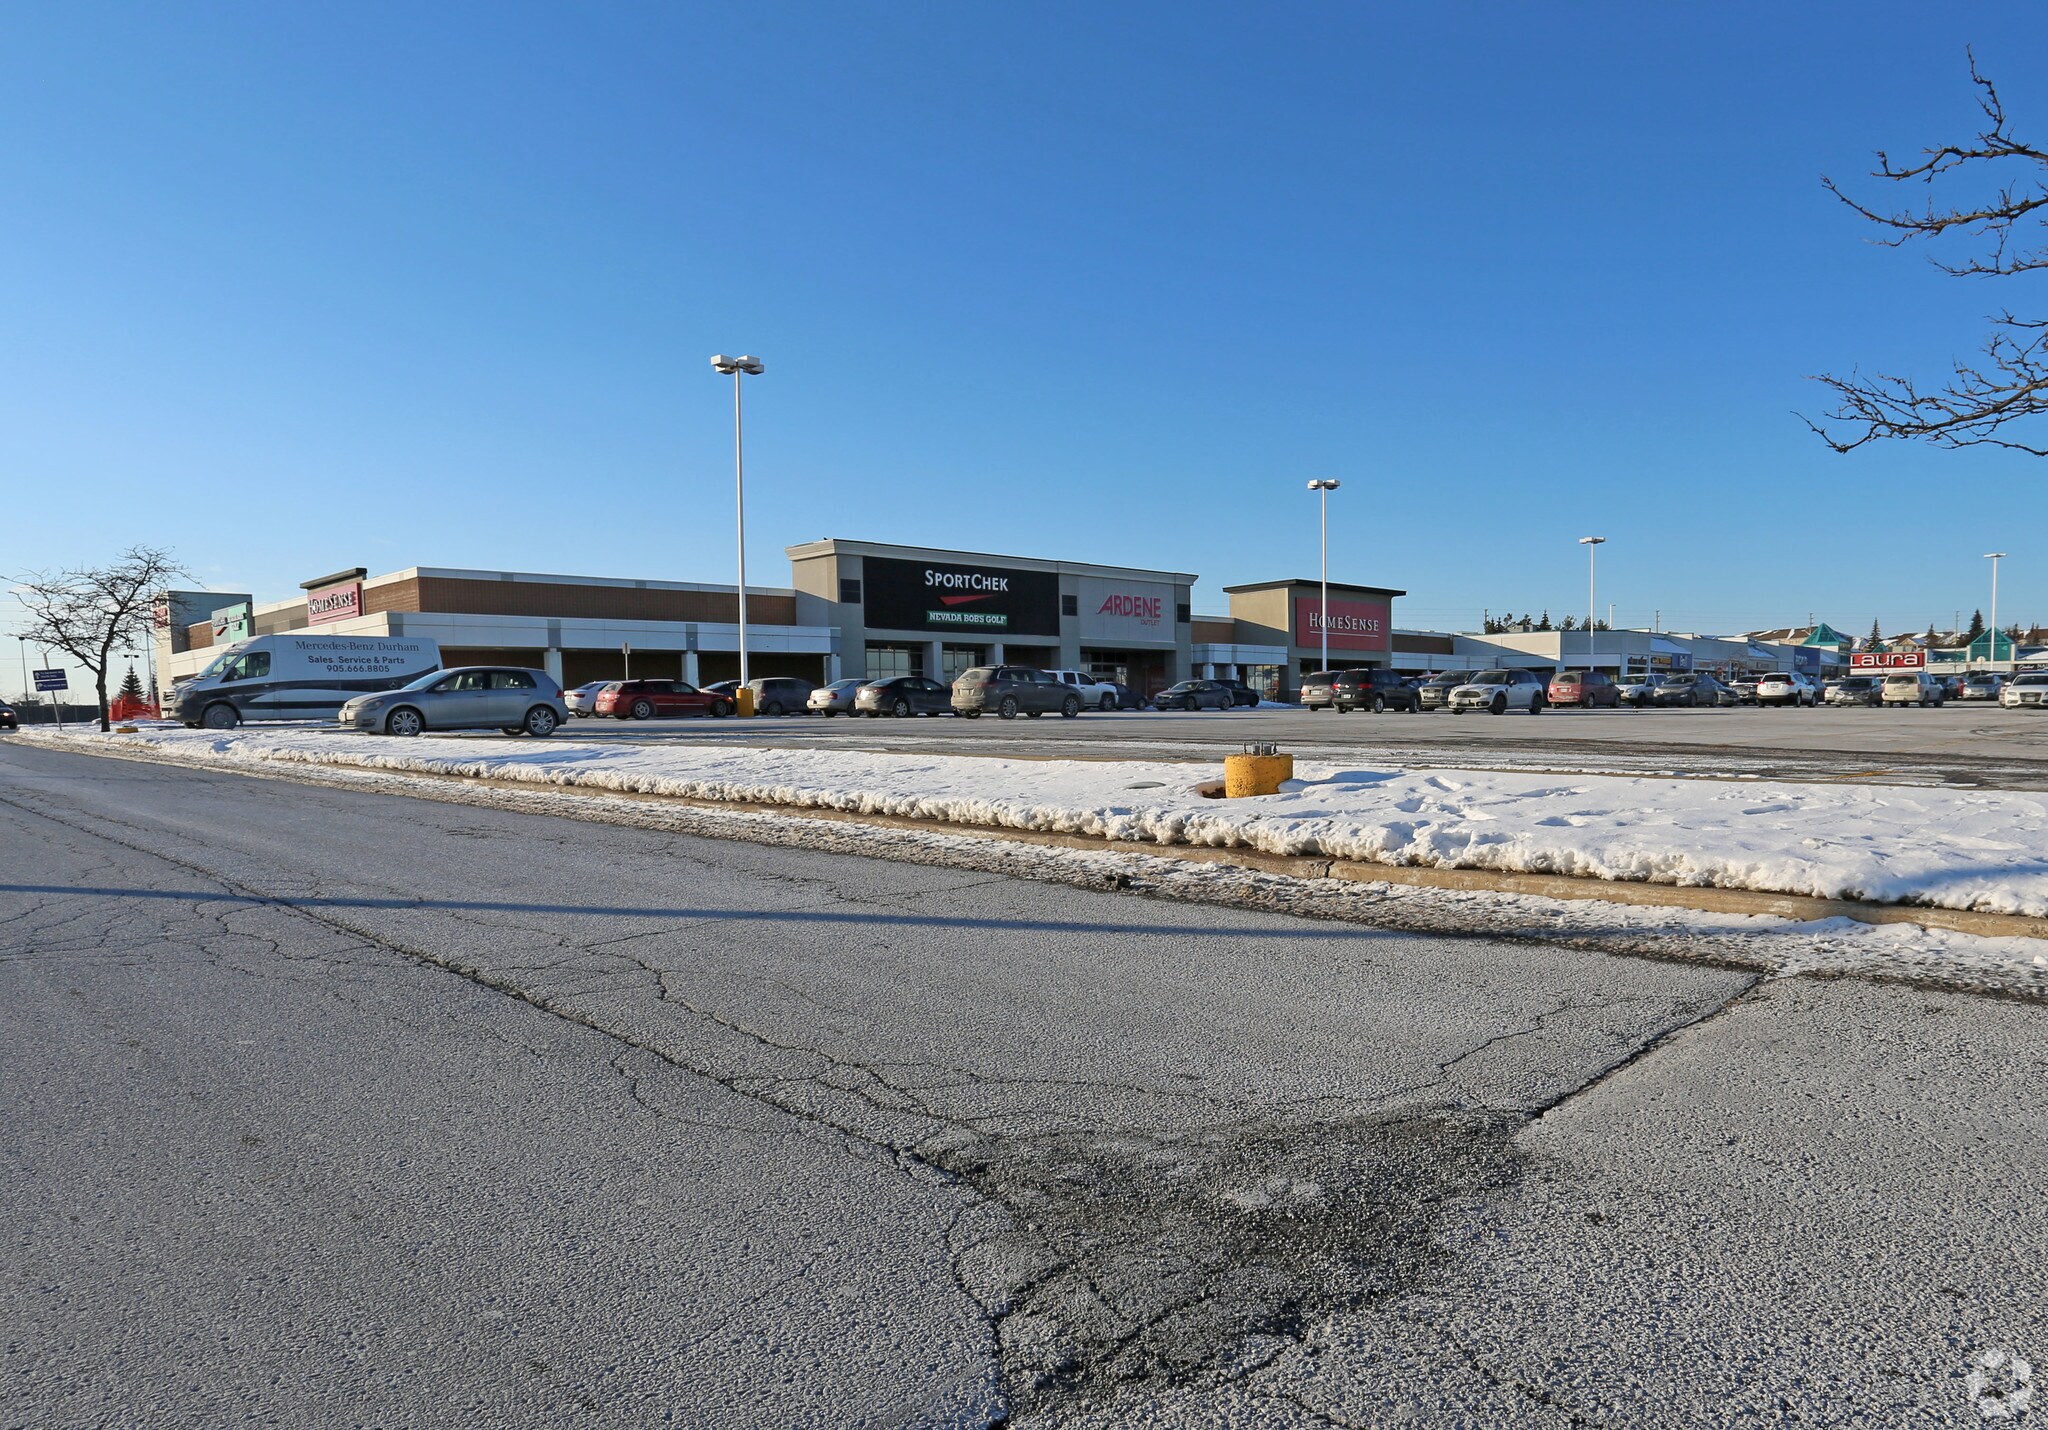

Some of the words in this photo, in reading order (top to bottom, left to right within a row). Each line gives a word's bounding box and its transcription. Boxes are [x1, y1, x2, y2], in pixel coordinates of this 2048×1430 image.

[924, 569, 1008, 592] SPORTCHEK
[1096, 594, 1161, 618] ARDENE
[929, 612, 962, 622] NEVADA
[985, 615, 1006, 624] GOLF
[295, 641, 374, 651] Mercedes-Benz
[377, 641, 419, 652] Durham
[308, 655, 333, 664] Sales
[338, 656, 371, 664] Service
[373, 656, 380, 664] &
[382, 657, 405, 665] Parts
[326, 665, 389, 673] 905.666.8805
